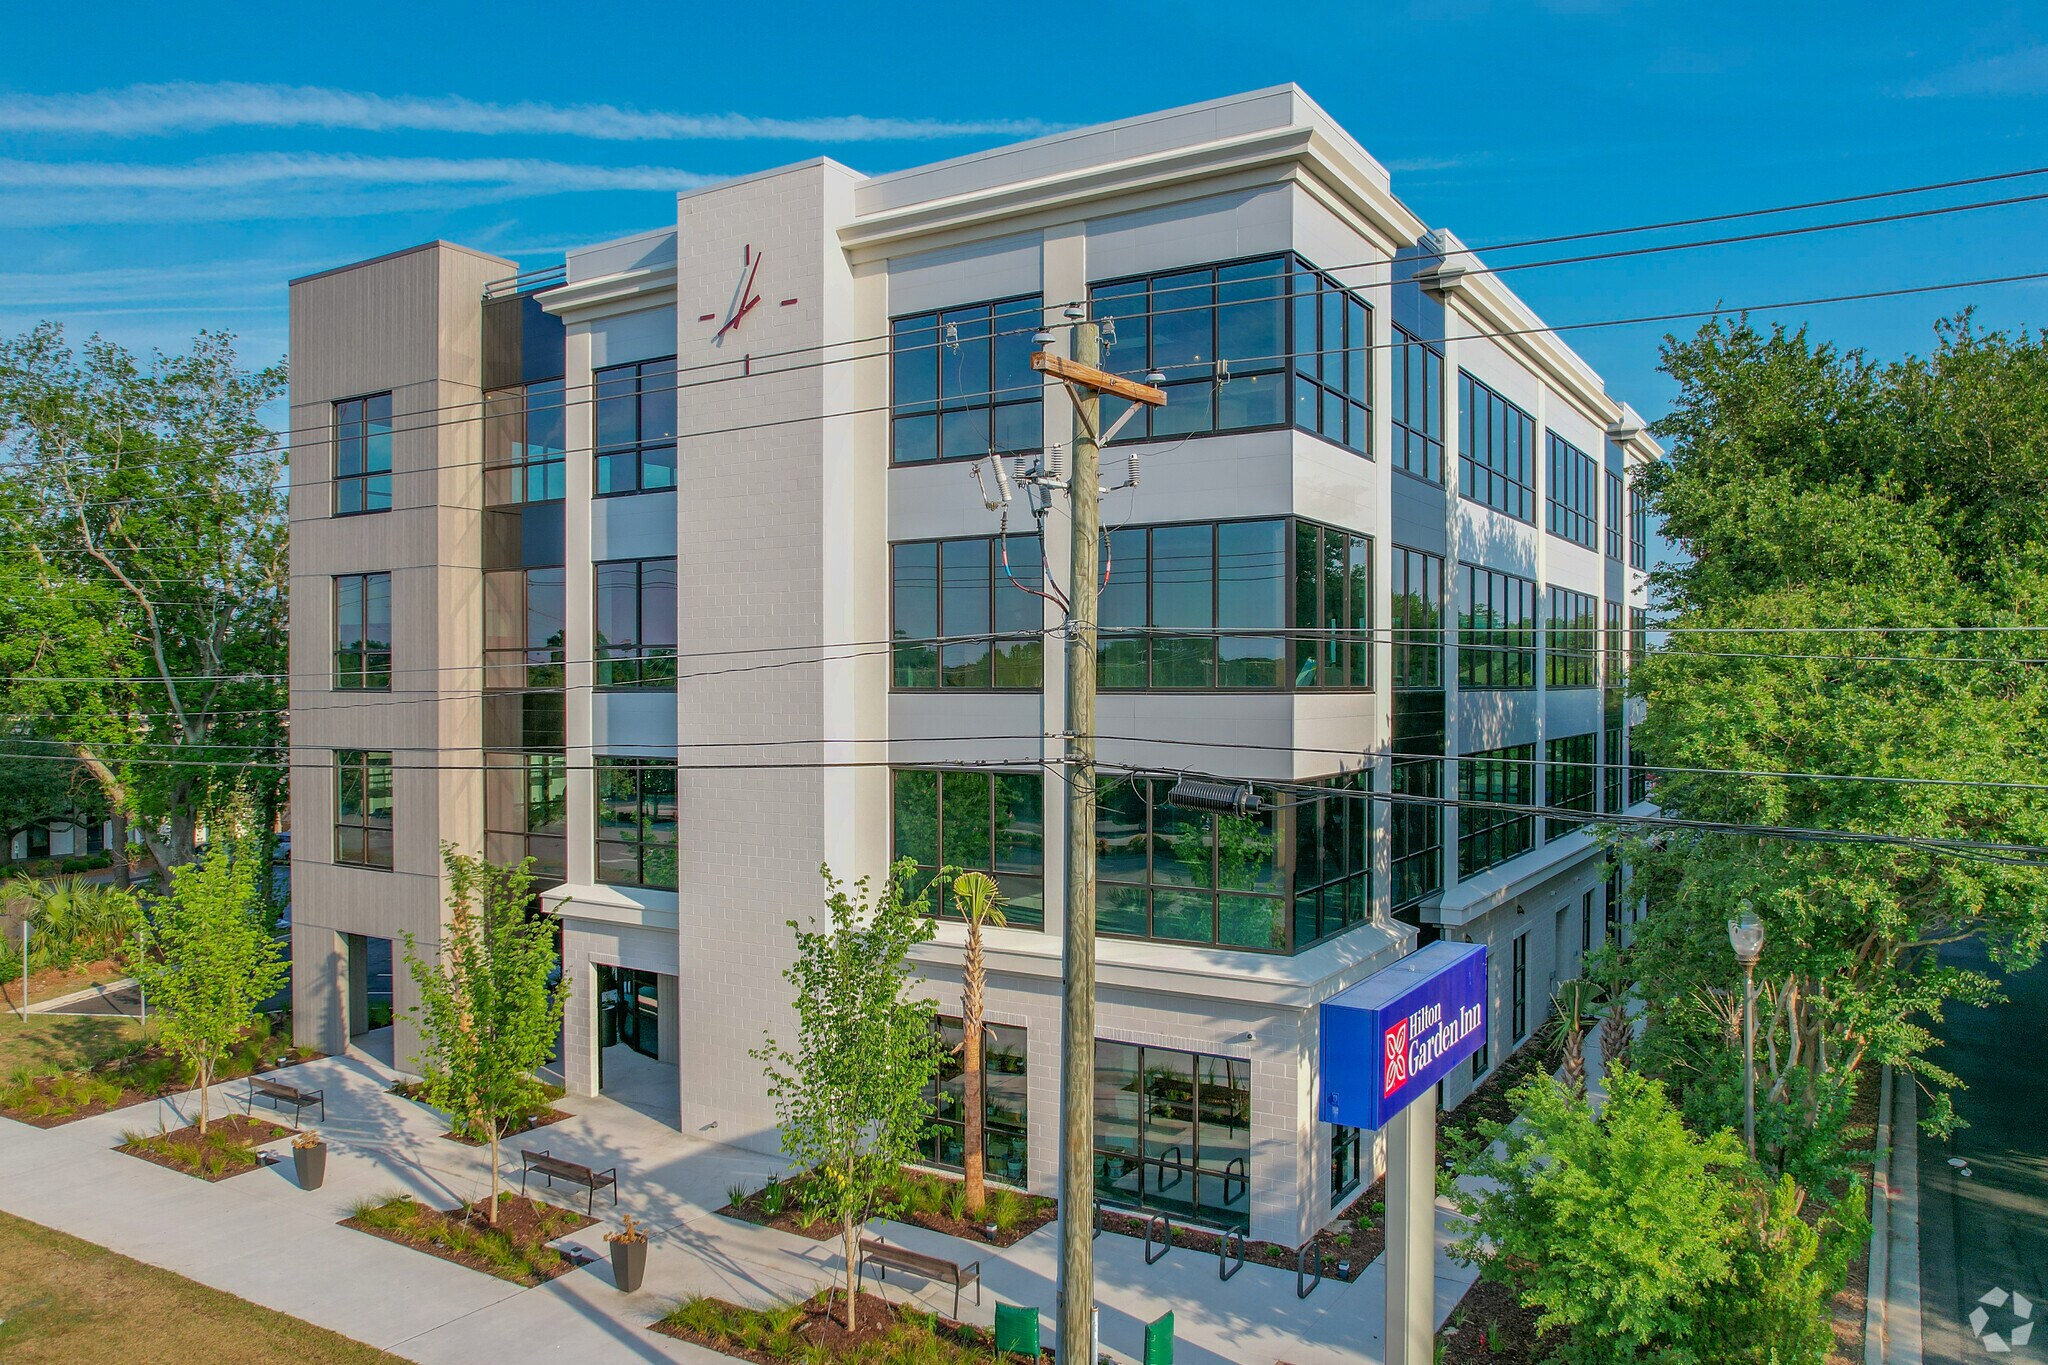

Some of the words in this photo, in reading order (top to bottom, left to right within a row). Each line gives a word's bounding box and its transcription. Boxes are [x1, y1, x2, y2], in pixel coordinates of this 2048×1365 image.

[1408, 1019, 1458, 1076] Garden
[1460, 1003, 1481, 1039] Inn
[1409, 1003, 1441, 1040] Hilton
